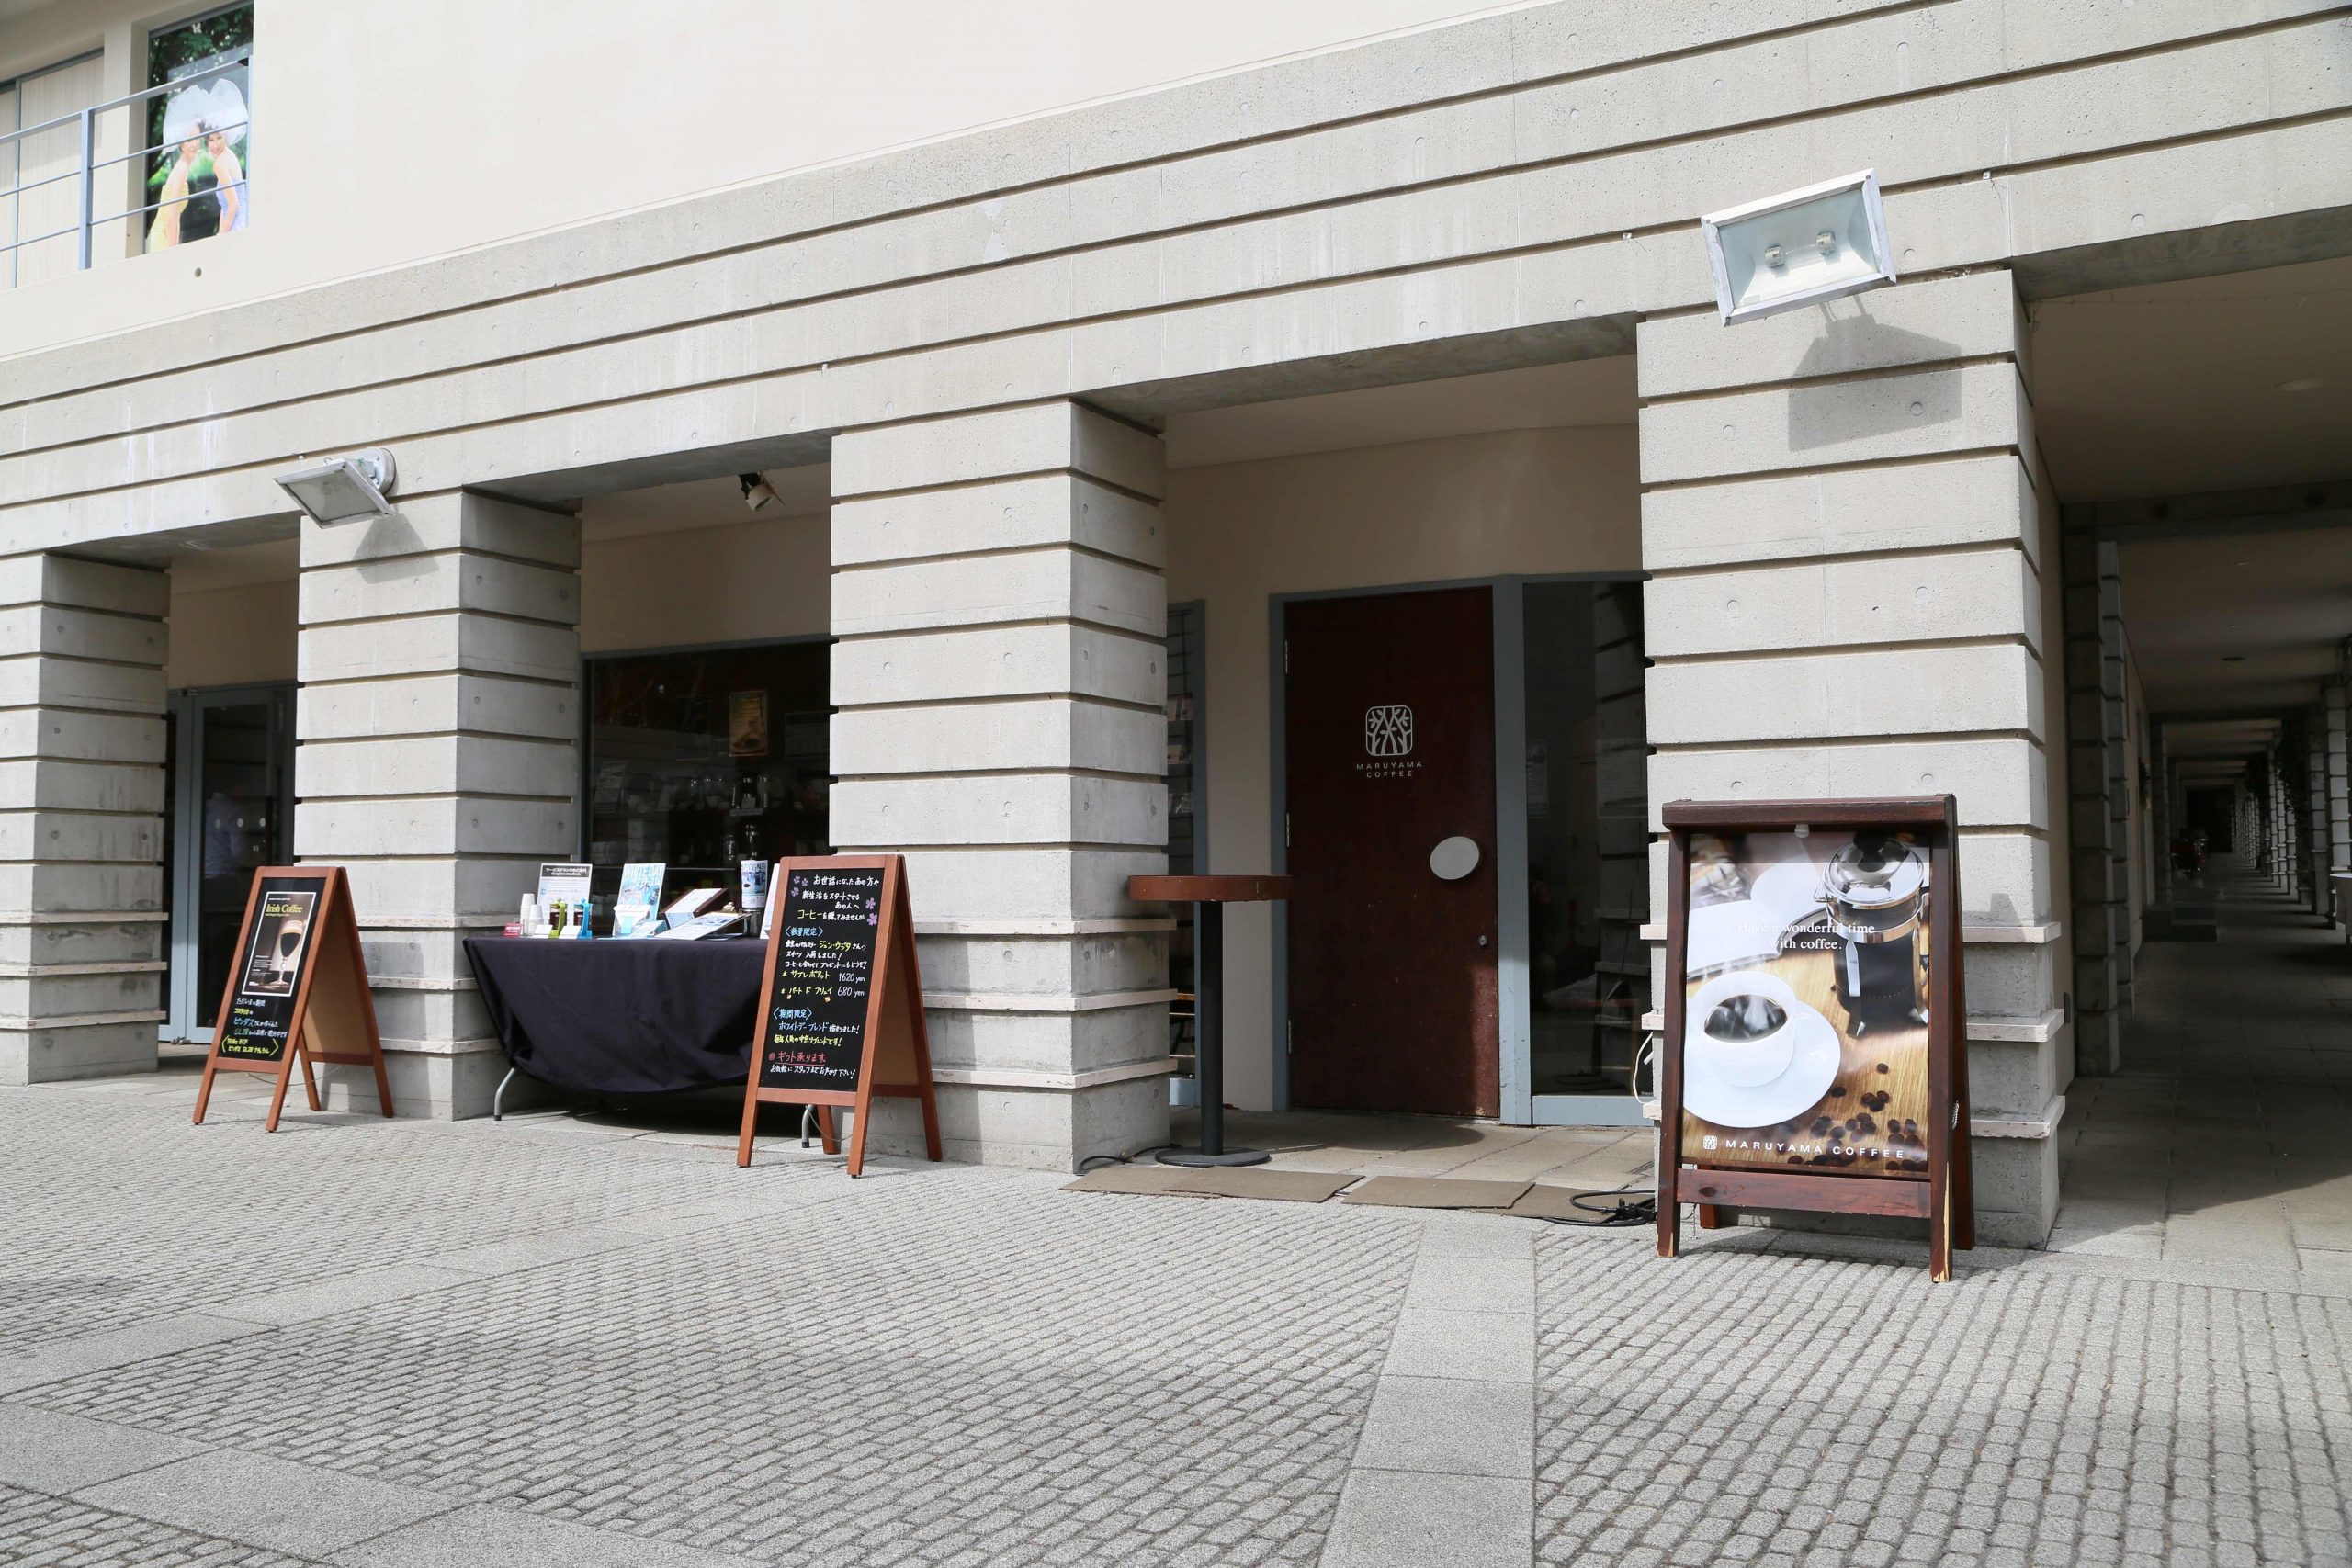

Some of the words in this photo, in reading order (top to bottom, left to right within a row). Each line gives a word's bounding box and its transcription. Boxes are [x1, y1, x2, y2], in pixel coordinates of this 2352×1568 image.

[1356, 761, 1422, 770] MARUYAMA
[266, 903, 280, 913] Irish
[281, 904, 303, 913] Coffee
[1782, 922, 1843, 933] wonderful
[1847, 923, 1875, 934] time
[1770, 939, 1797, 949] with
[1800, 939, 1842, 950] coffee.
[838, 972, 855, 982] 1620
[837, 986, 852, 996] 680
[1726, 1139, 1823, 1154] MARUYAMA
[1832, 1145, 1904, 1158] COFFEE
